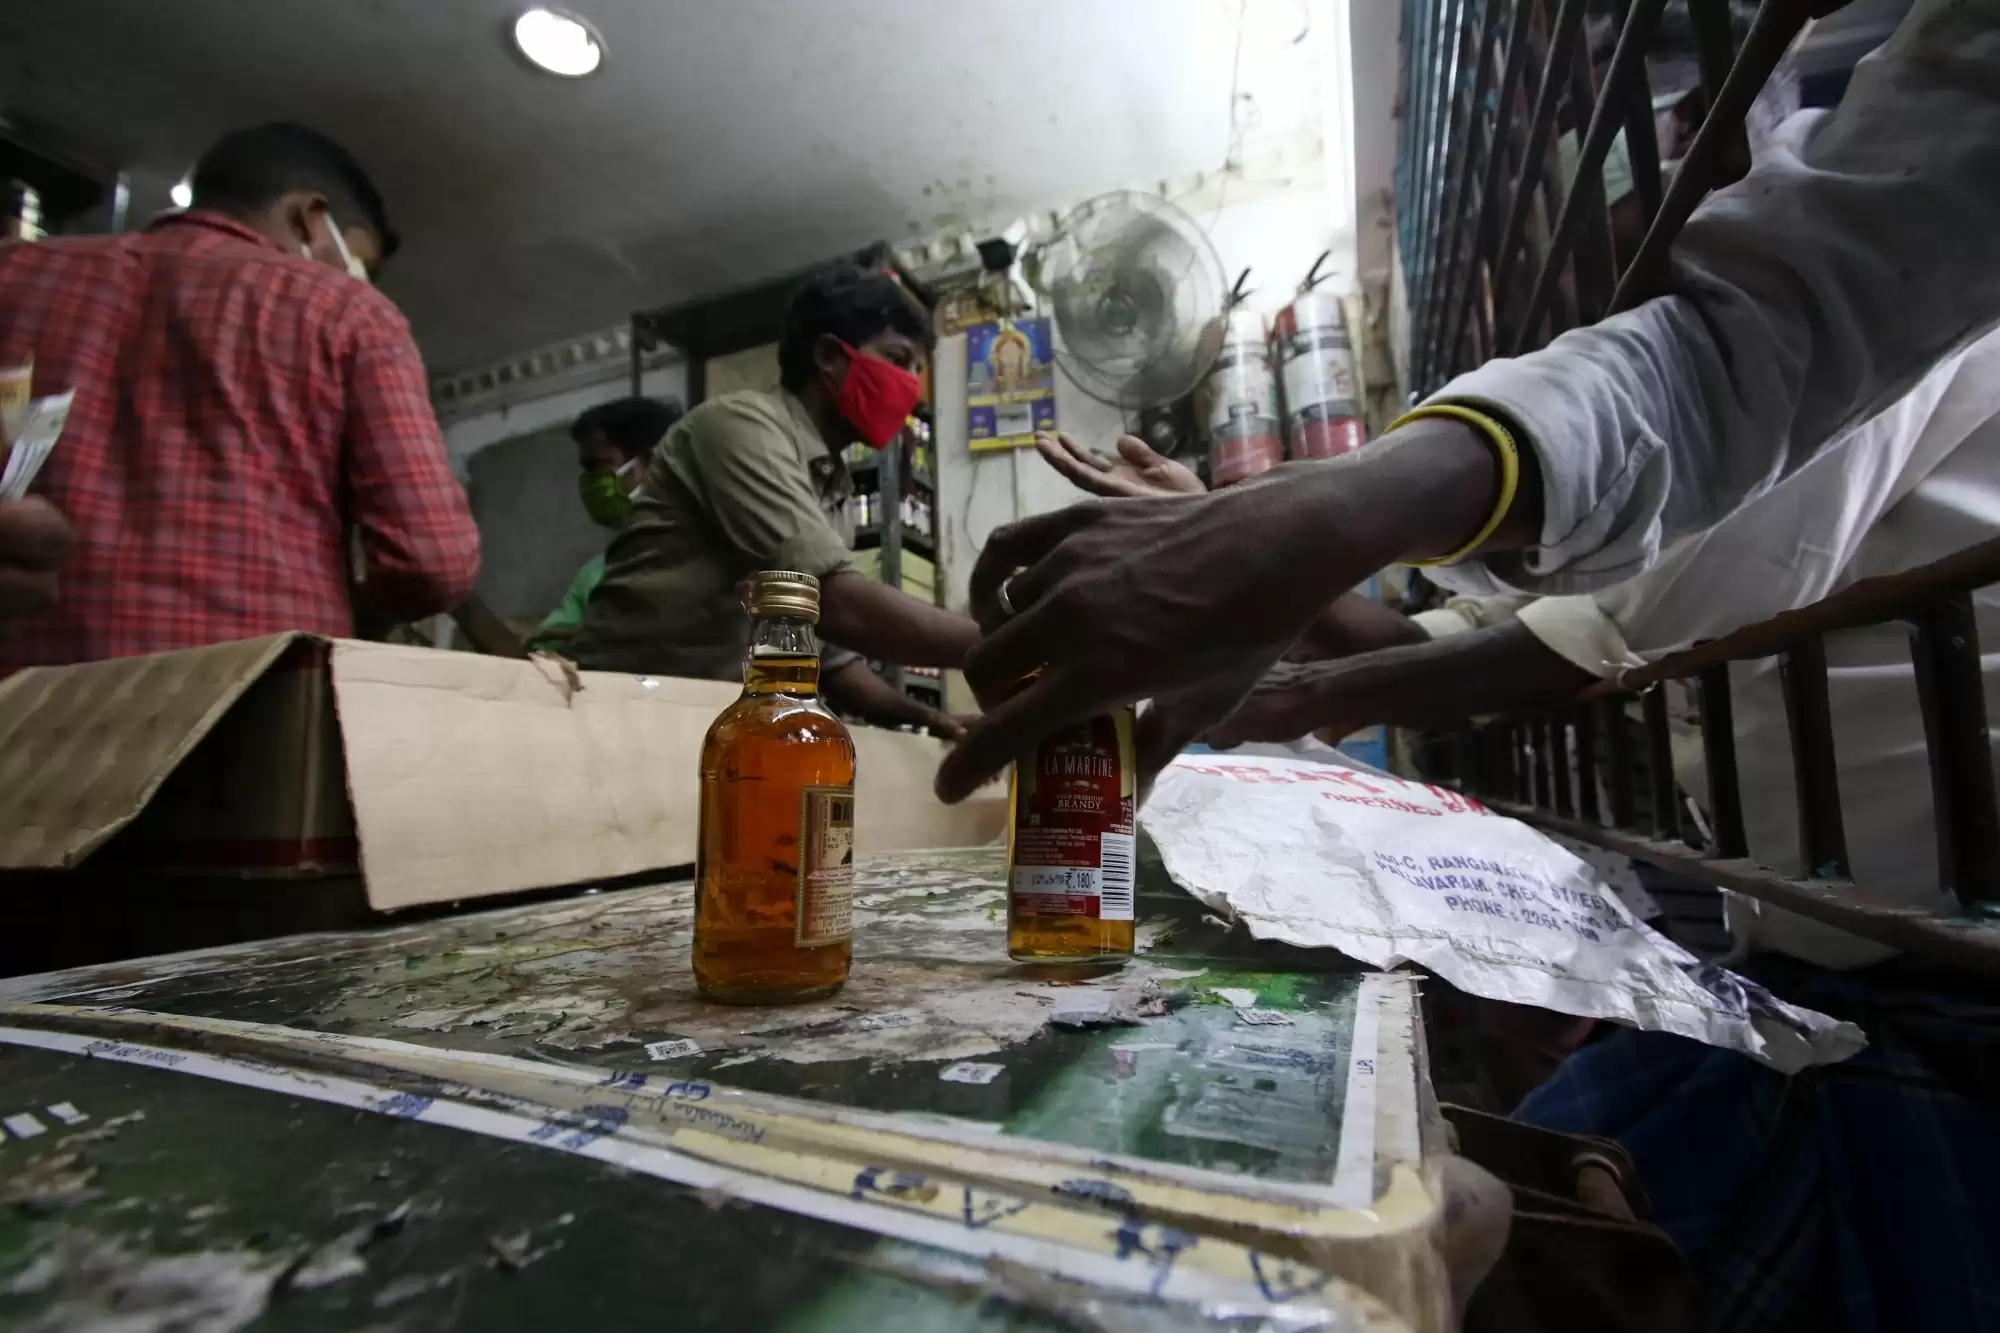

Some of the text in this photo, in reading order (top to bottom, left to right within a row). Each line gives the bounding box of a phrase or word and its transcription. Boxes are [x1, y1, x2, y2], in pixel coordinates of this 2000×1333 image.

[1045, 755, 1113, 778] LA MARTINE
[1058, 800, 1101, 810] BRANDY
[1443, 895, 1508, 919] PHONE
